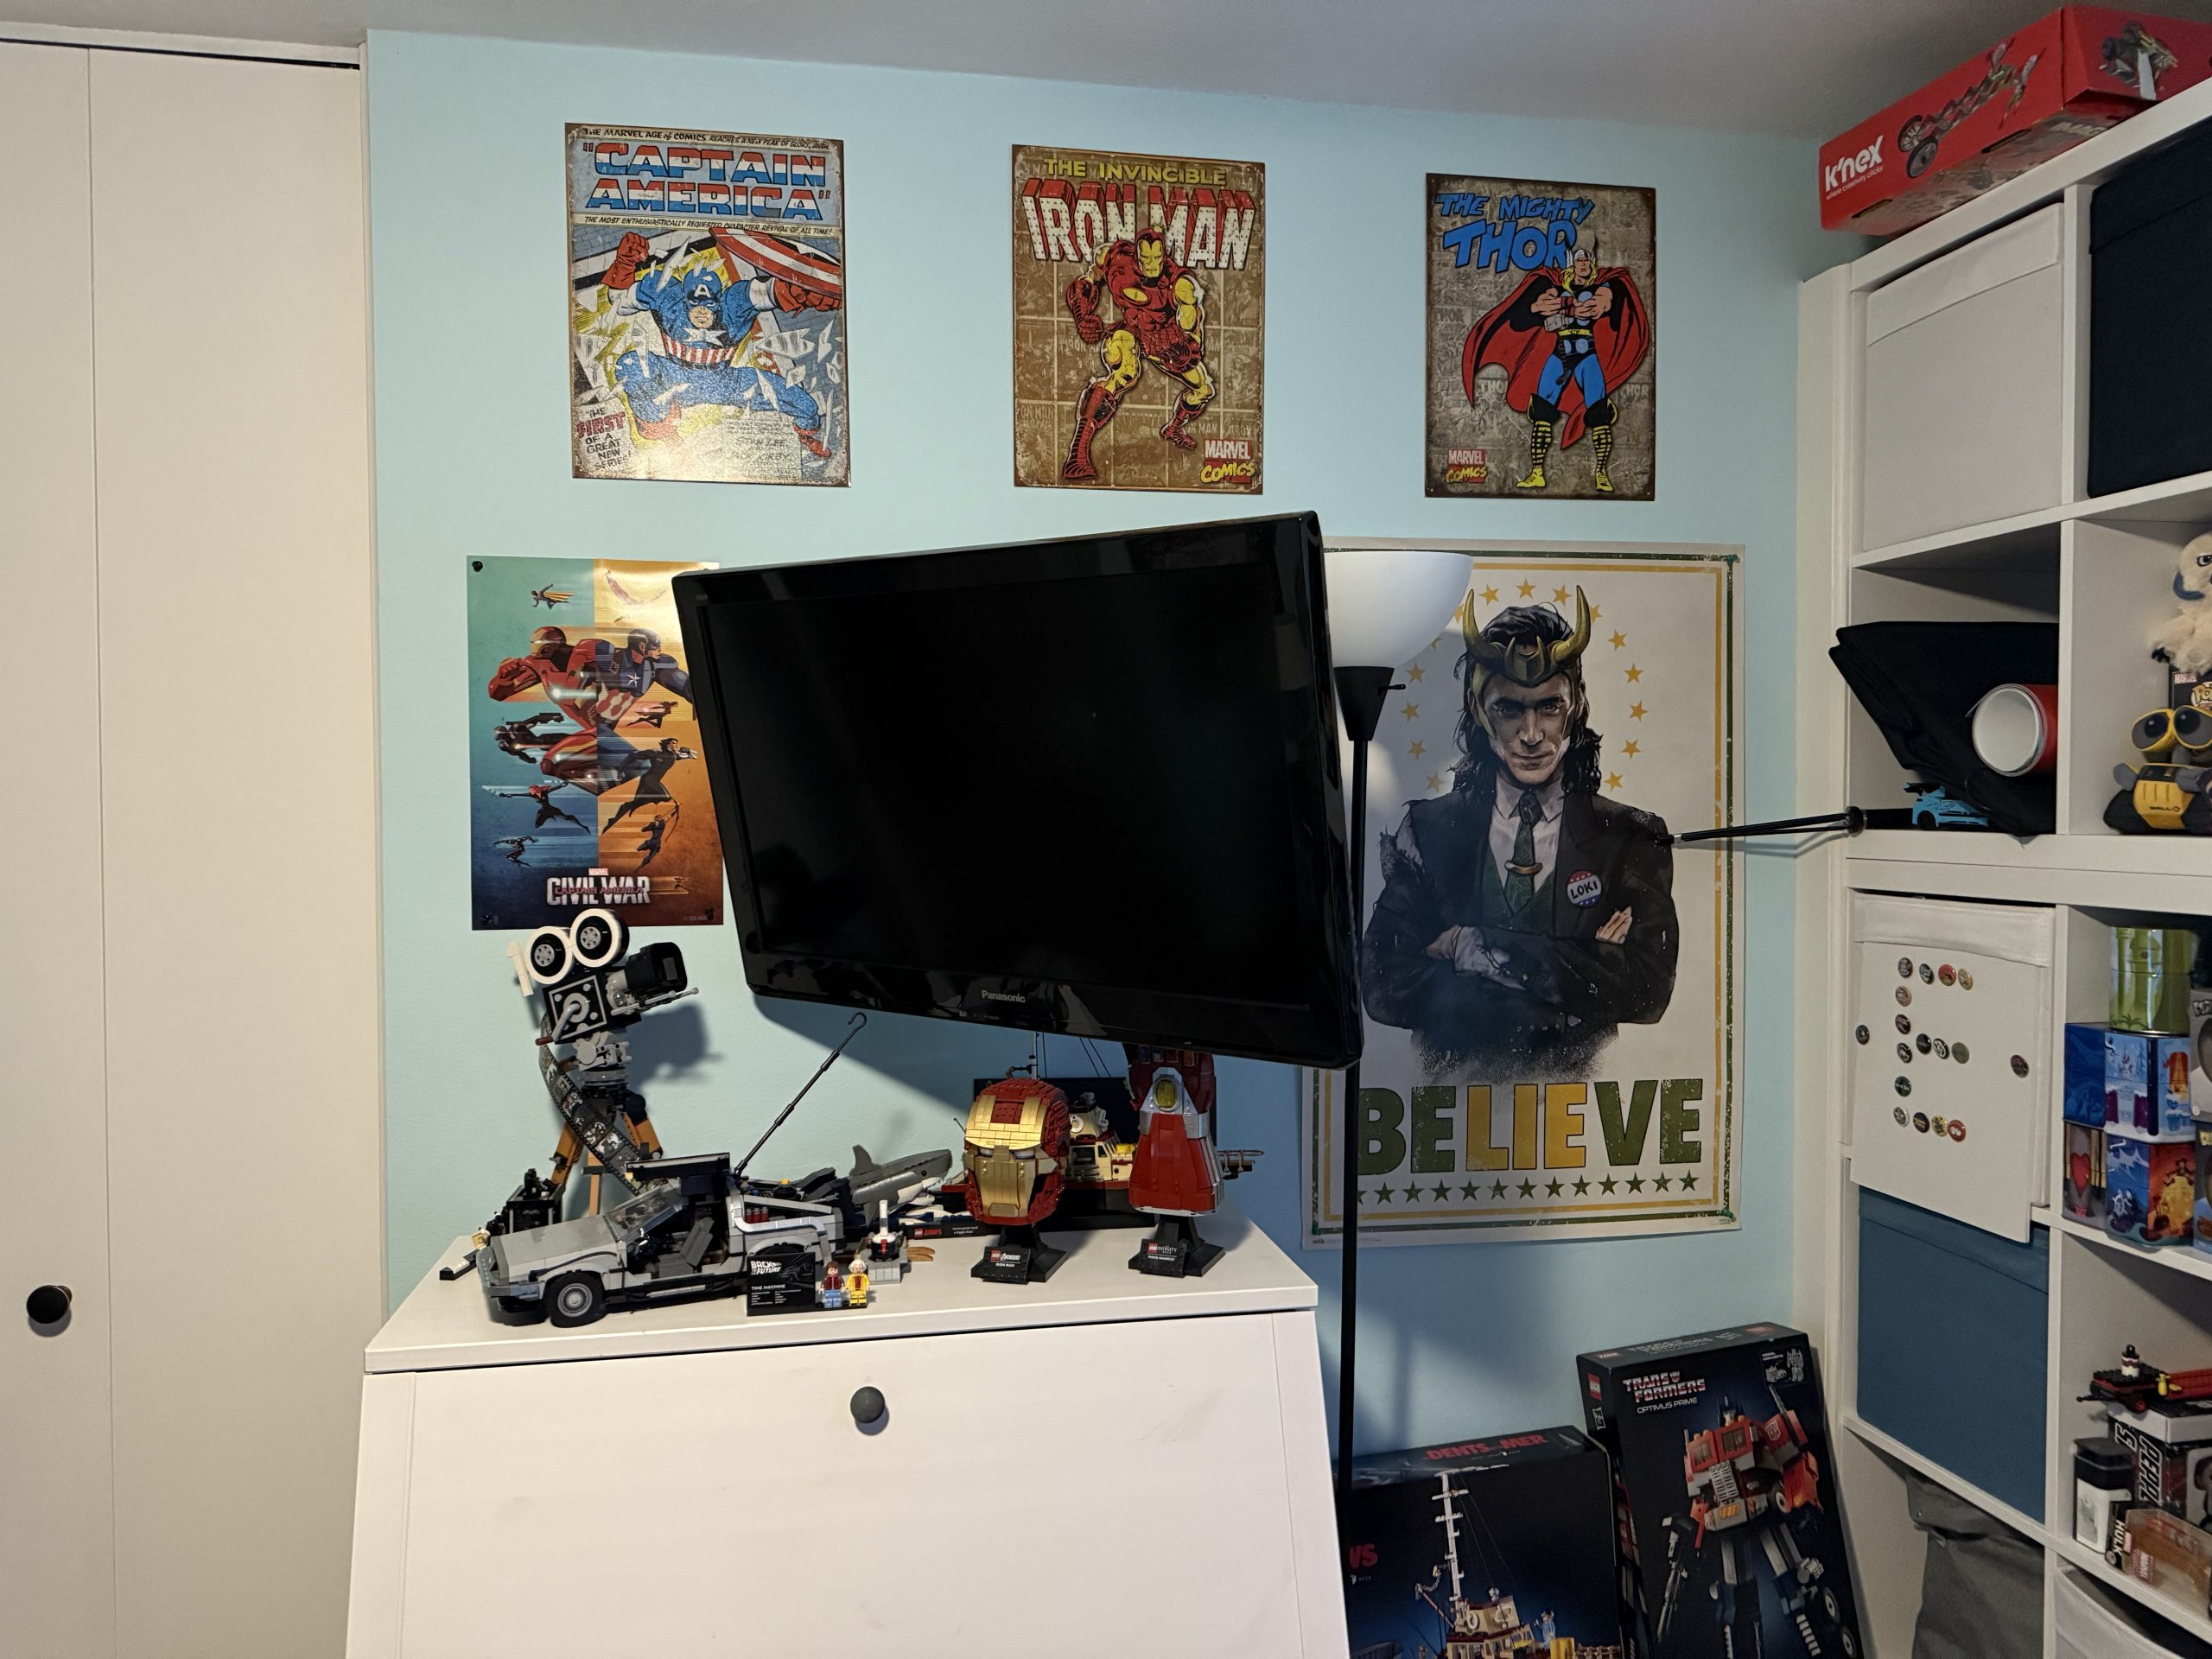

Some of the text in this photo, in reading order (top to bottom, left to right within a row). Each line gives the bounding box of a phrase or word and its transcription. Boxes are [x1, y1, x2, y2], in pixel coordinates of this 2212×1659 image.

[604, 129, 645, 138] MARVEL
[673, 133, 707, 142] COMICS
[709, 135, 740, 143] REACHES
[1043, 159, 1226, 186] THE INVINCIBLE
[1434, 193, 1596, 226] THE MIGHTY
[622, 218, 687, 226] ENTHUSIASTICALLY
[760, 225, 790, 233] REVIVAL
[1021, 178, 1255, 270] IRON MAN
[1443, 219, 1577, 274] THOR
[589, 407, 606, 418] THE
[576, 411, 626, 439] FIRST
[585, 435, 600, 444] OF
[587, 438, 621, 454] GREAT
[598, 448, 620, 461] NEW
[1205, 440, 1251, 459] MARVEL
[1448, 449, 1484, 465] MARVEL
[1200, 461, 1255, 483] COMICS
[1445, 466, 1488, 483] COMICS
[546, 875, 651, 905] CIVIL WAR
[1570, 880, 1599, 899] LOKI
[981, 988, 1027, 1003] Panasonic
[1357, 1078, 1704, 1176] BELIEVE
[756, 1266, 782, 1274] FUTURE
[1622, 1371, 1669, 1392] TRANS
[1634, 1378, 1707, 1402] FORMERS
[1637, 1396, 1698, 1414] OPTIMUS PRIME
[1426, 1442, 1491, 1460] DENTS
[1499, 1434, 1548, 1450] MER
[2113, 1518, 2126, 1557] HULK
